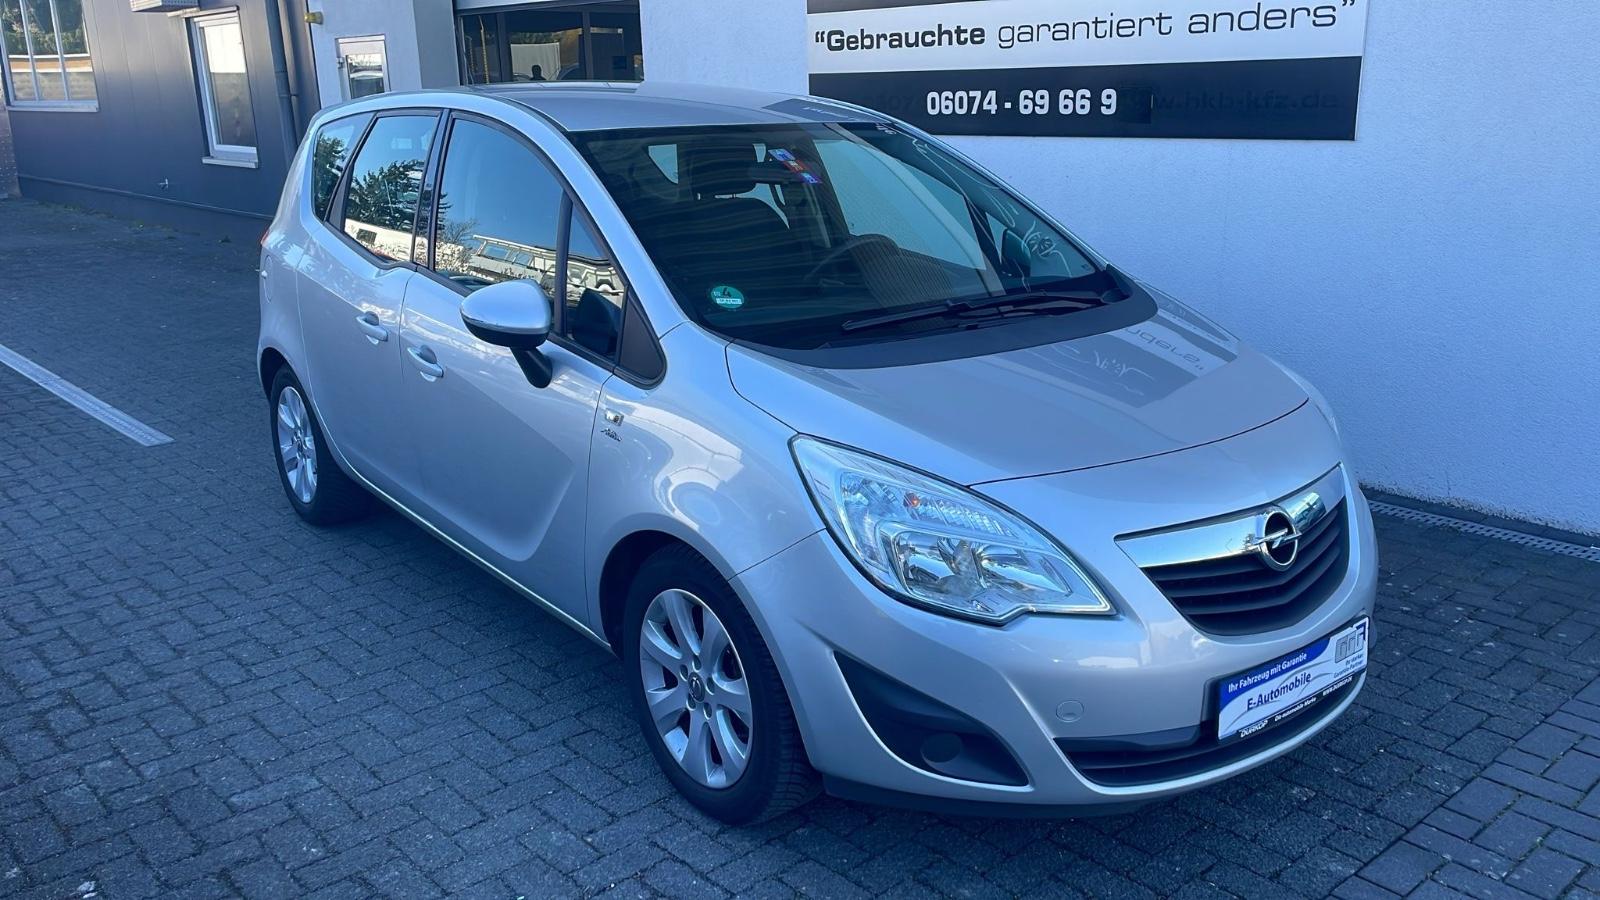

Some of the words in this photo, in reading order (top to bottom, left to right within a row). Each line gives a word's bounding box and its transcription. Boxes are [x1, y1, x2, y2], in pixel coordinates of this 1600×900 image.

[998, 12, 1173, 49] garantiert
[926, 90, 998, 116] 06074
[1004, 101, 1012, 109] -
[1018, 89, 1050, 115] 69
[1058, 88, 1092, 115] 66
[1100, 88, 1117, 115] 9
[1228, 682, 1238, 693] Ihr
[1239, 669, 1270, 689] Fahrzeug
[1270, 663, 1282, 677] mit
[1281, 652, 1308, 670] Garantie
[1246, 670, 1312, 711] E-Automobile
